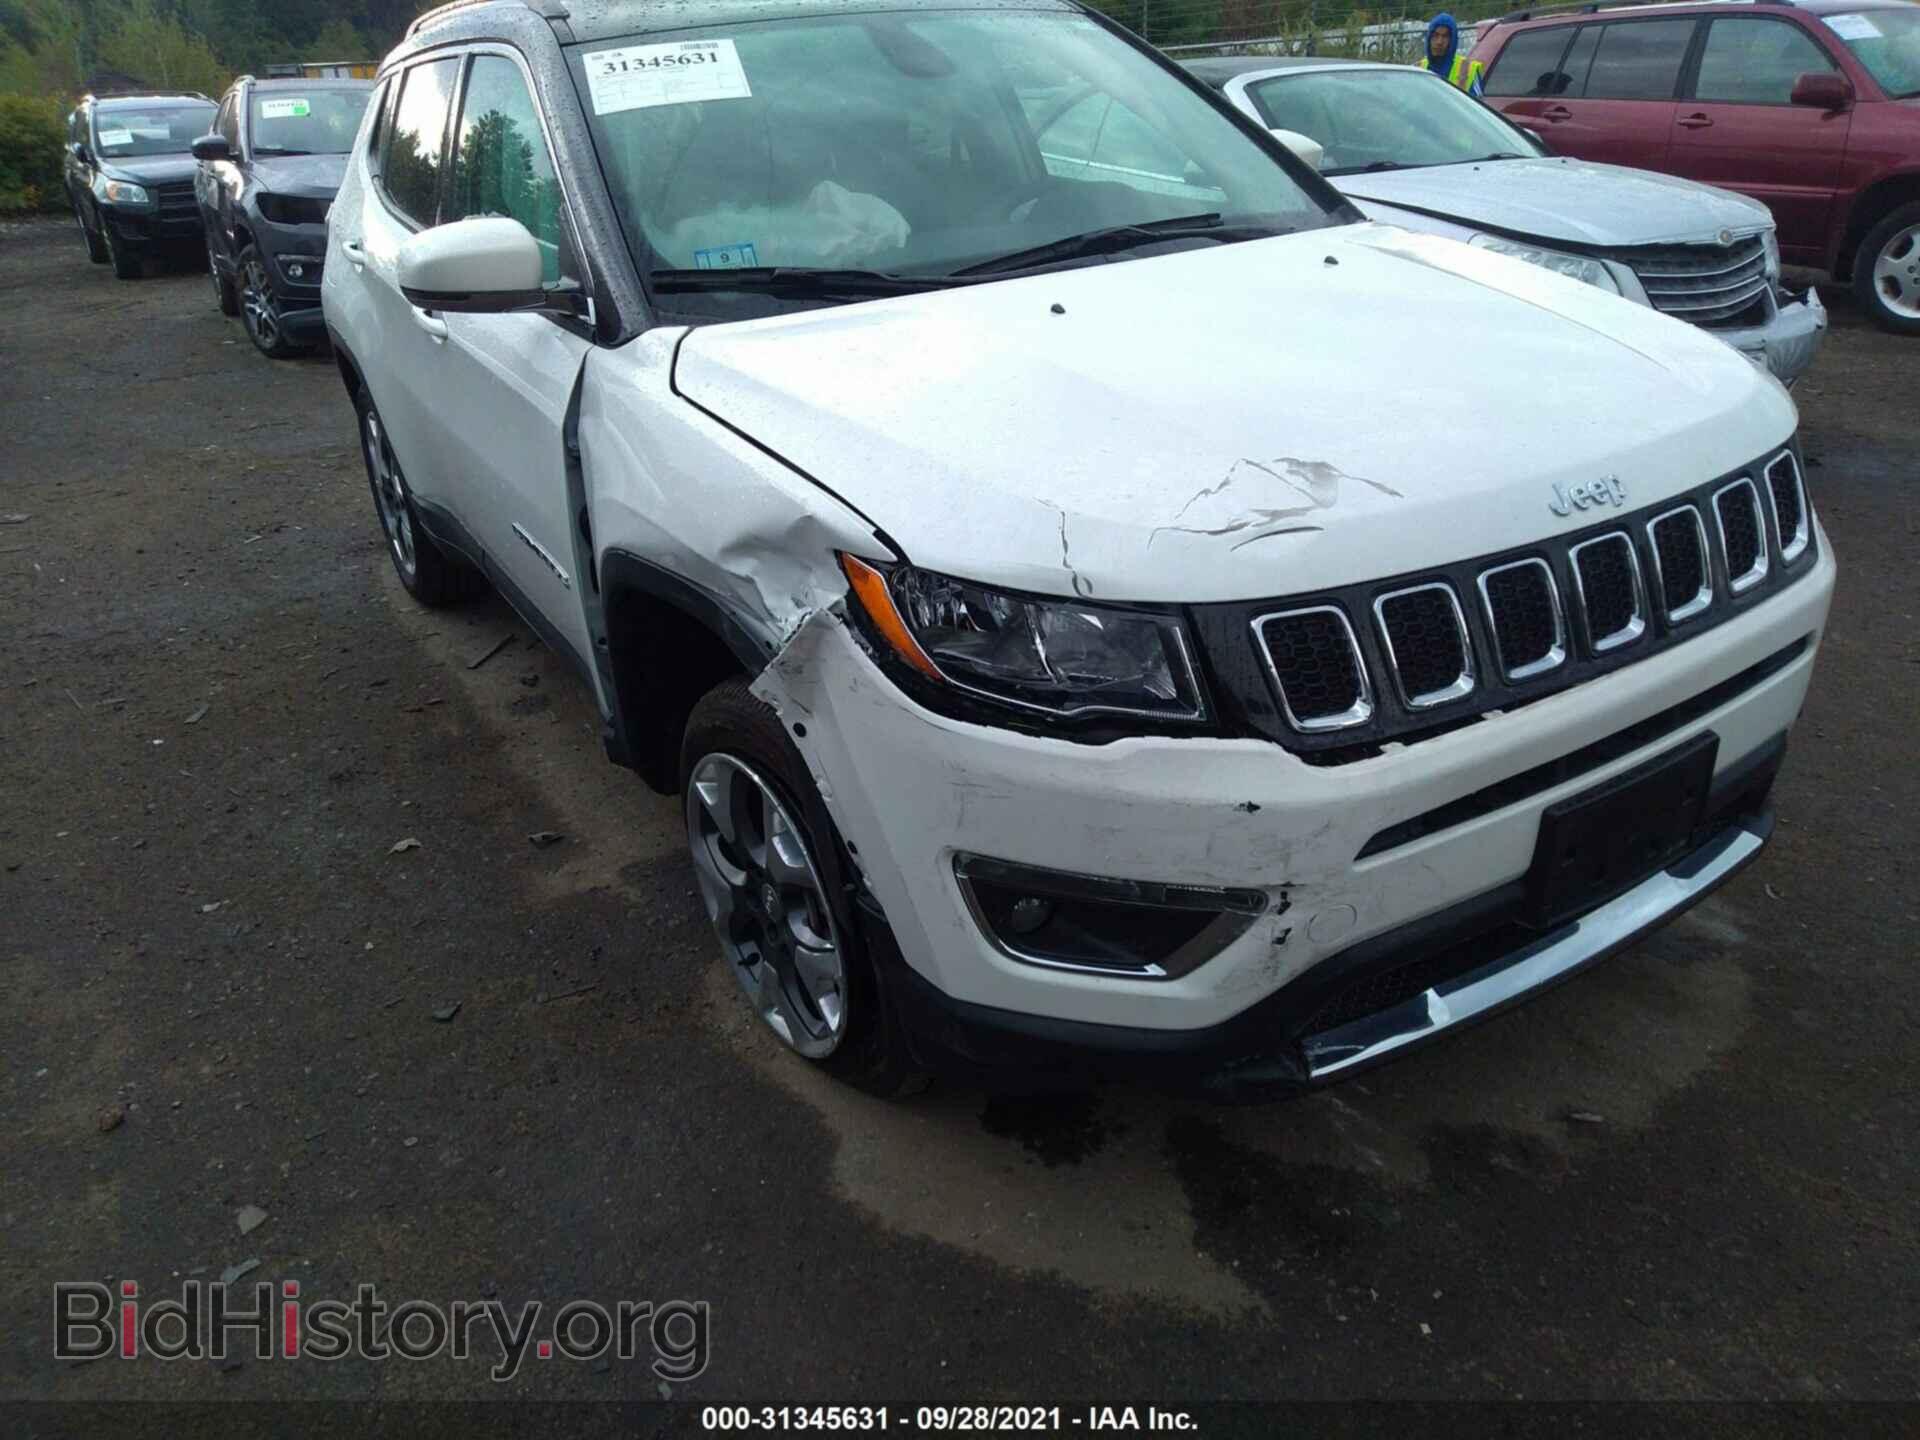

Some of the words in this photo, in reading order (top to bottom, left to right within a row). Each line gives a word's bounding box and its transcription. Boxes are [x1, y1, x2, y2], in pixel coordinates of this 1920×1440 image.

[603, 52, 719, 75] 31345631
[719, 252, 730, 264] 9
[1549, 474, 1627, 517] Jeep
